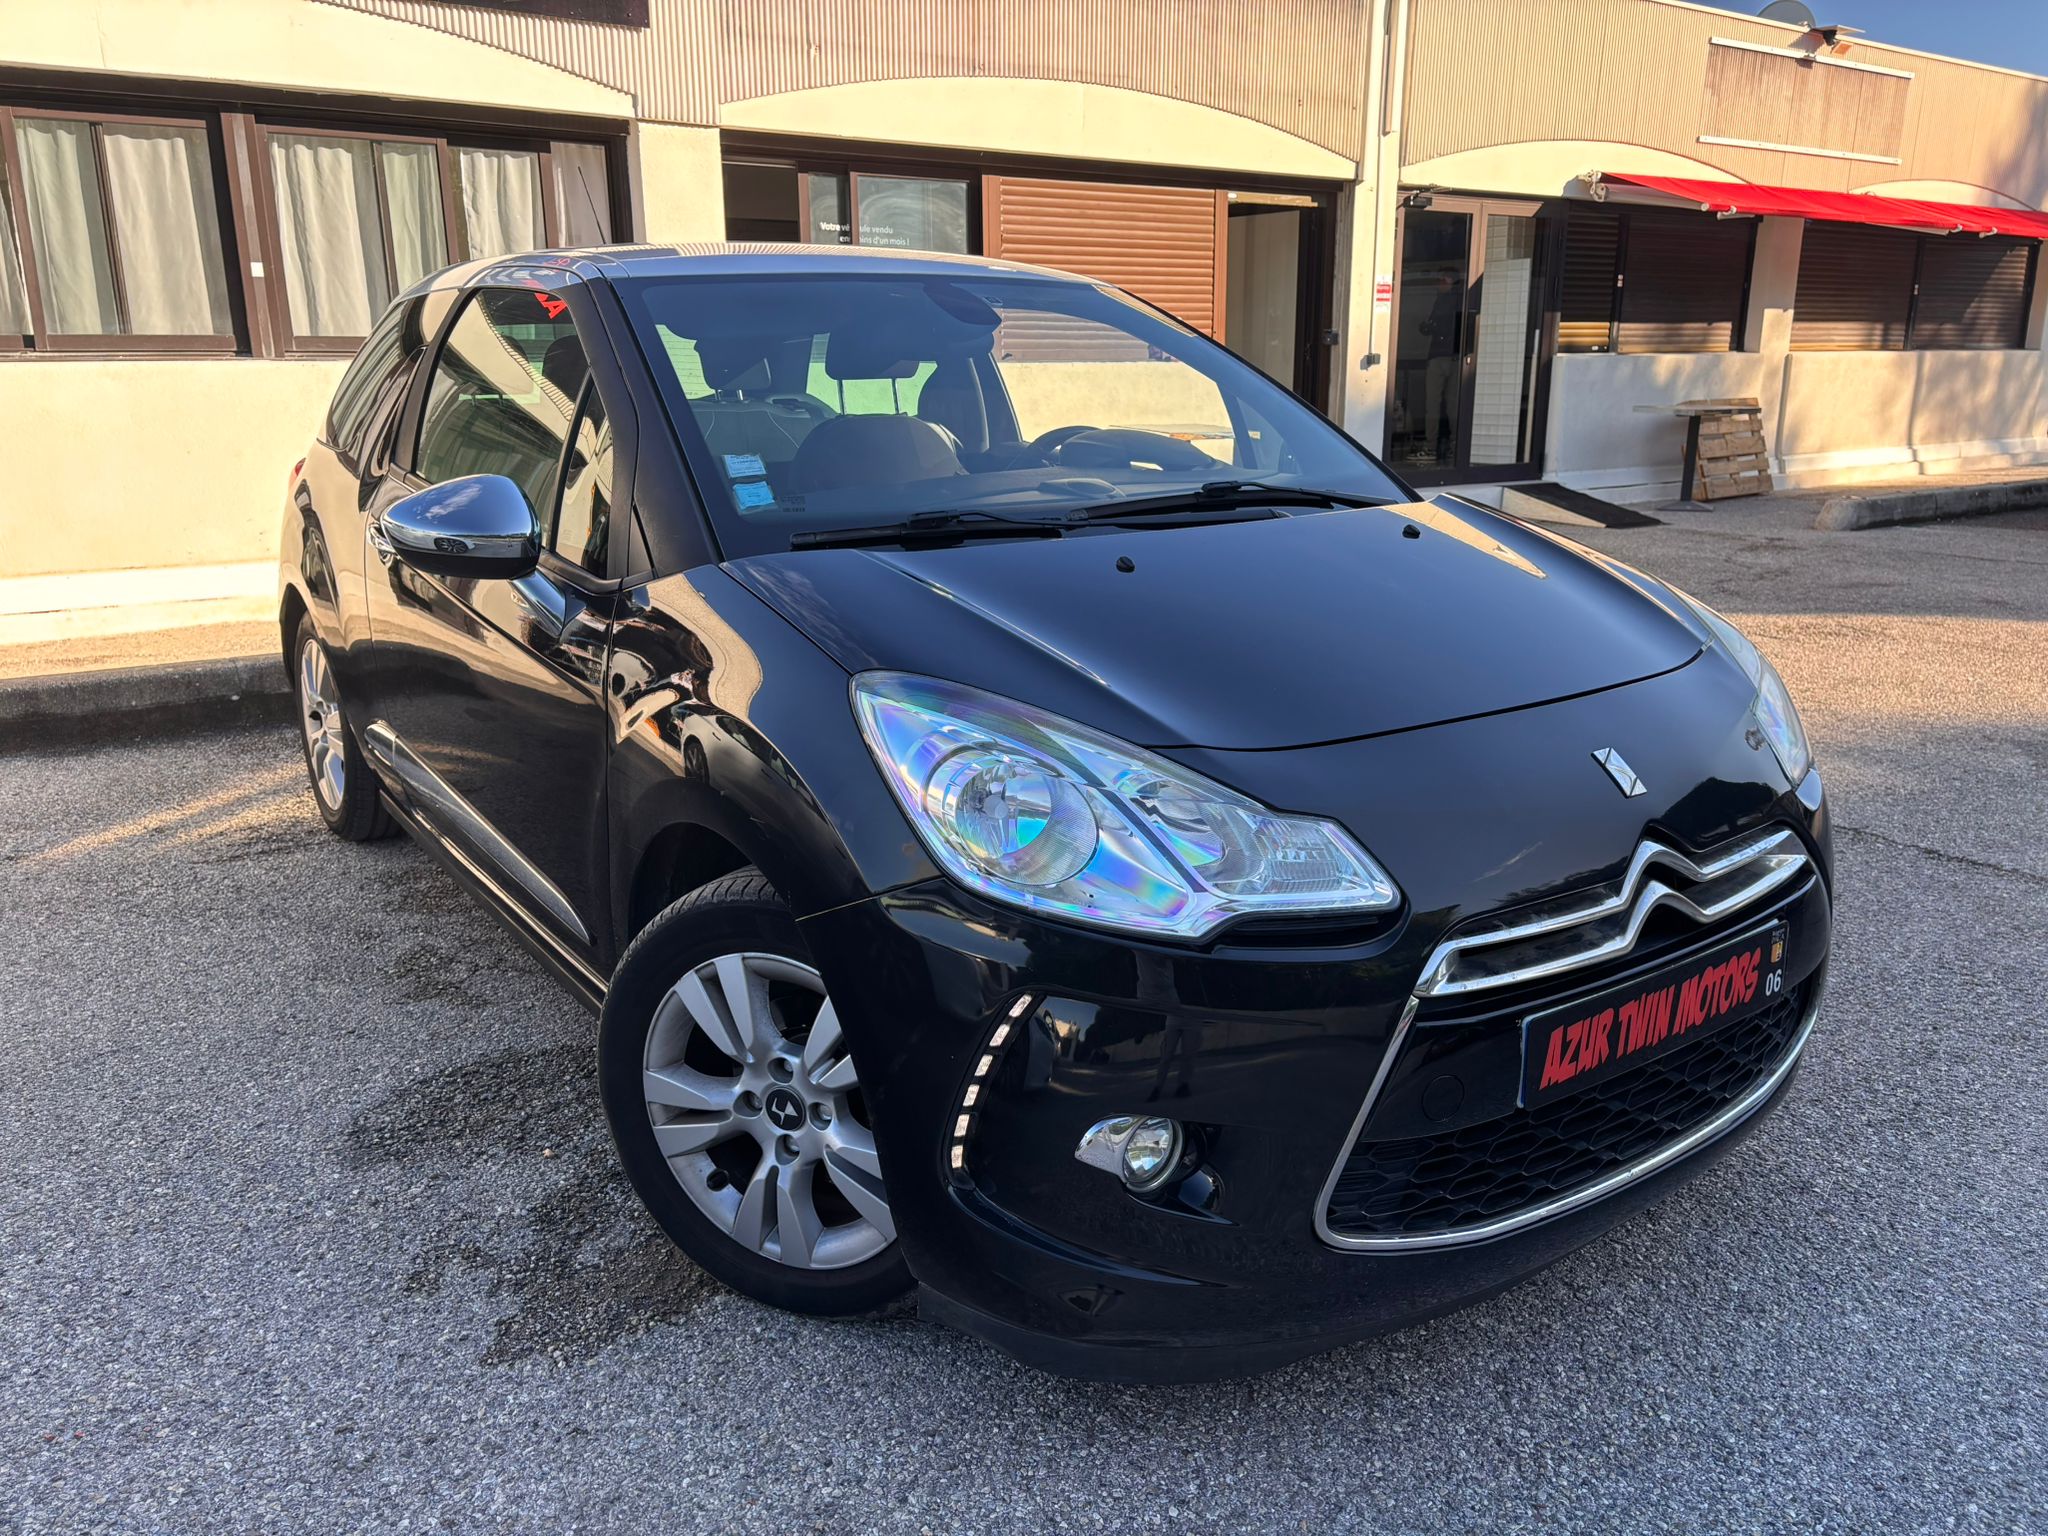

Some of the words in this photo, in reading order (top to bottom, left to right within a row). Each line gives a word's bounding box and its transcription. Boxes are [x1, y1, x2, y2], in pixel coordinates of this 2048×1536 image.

[820, 221, 841, 232] Votre
[872, 226, 893, 234] vendu
[873, 236, 889, 245] d'un
[889, 238, 906, 246] mois
[1765, 969, 1783, 997] 06
[1539, 1008, 1614, 1091] AZUR
[1616, 984, 1675, 1060] TWIN
[1672, 947, 1761, 1036] MOTORS
